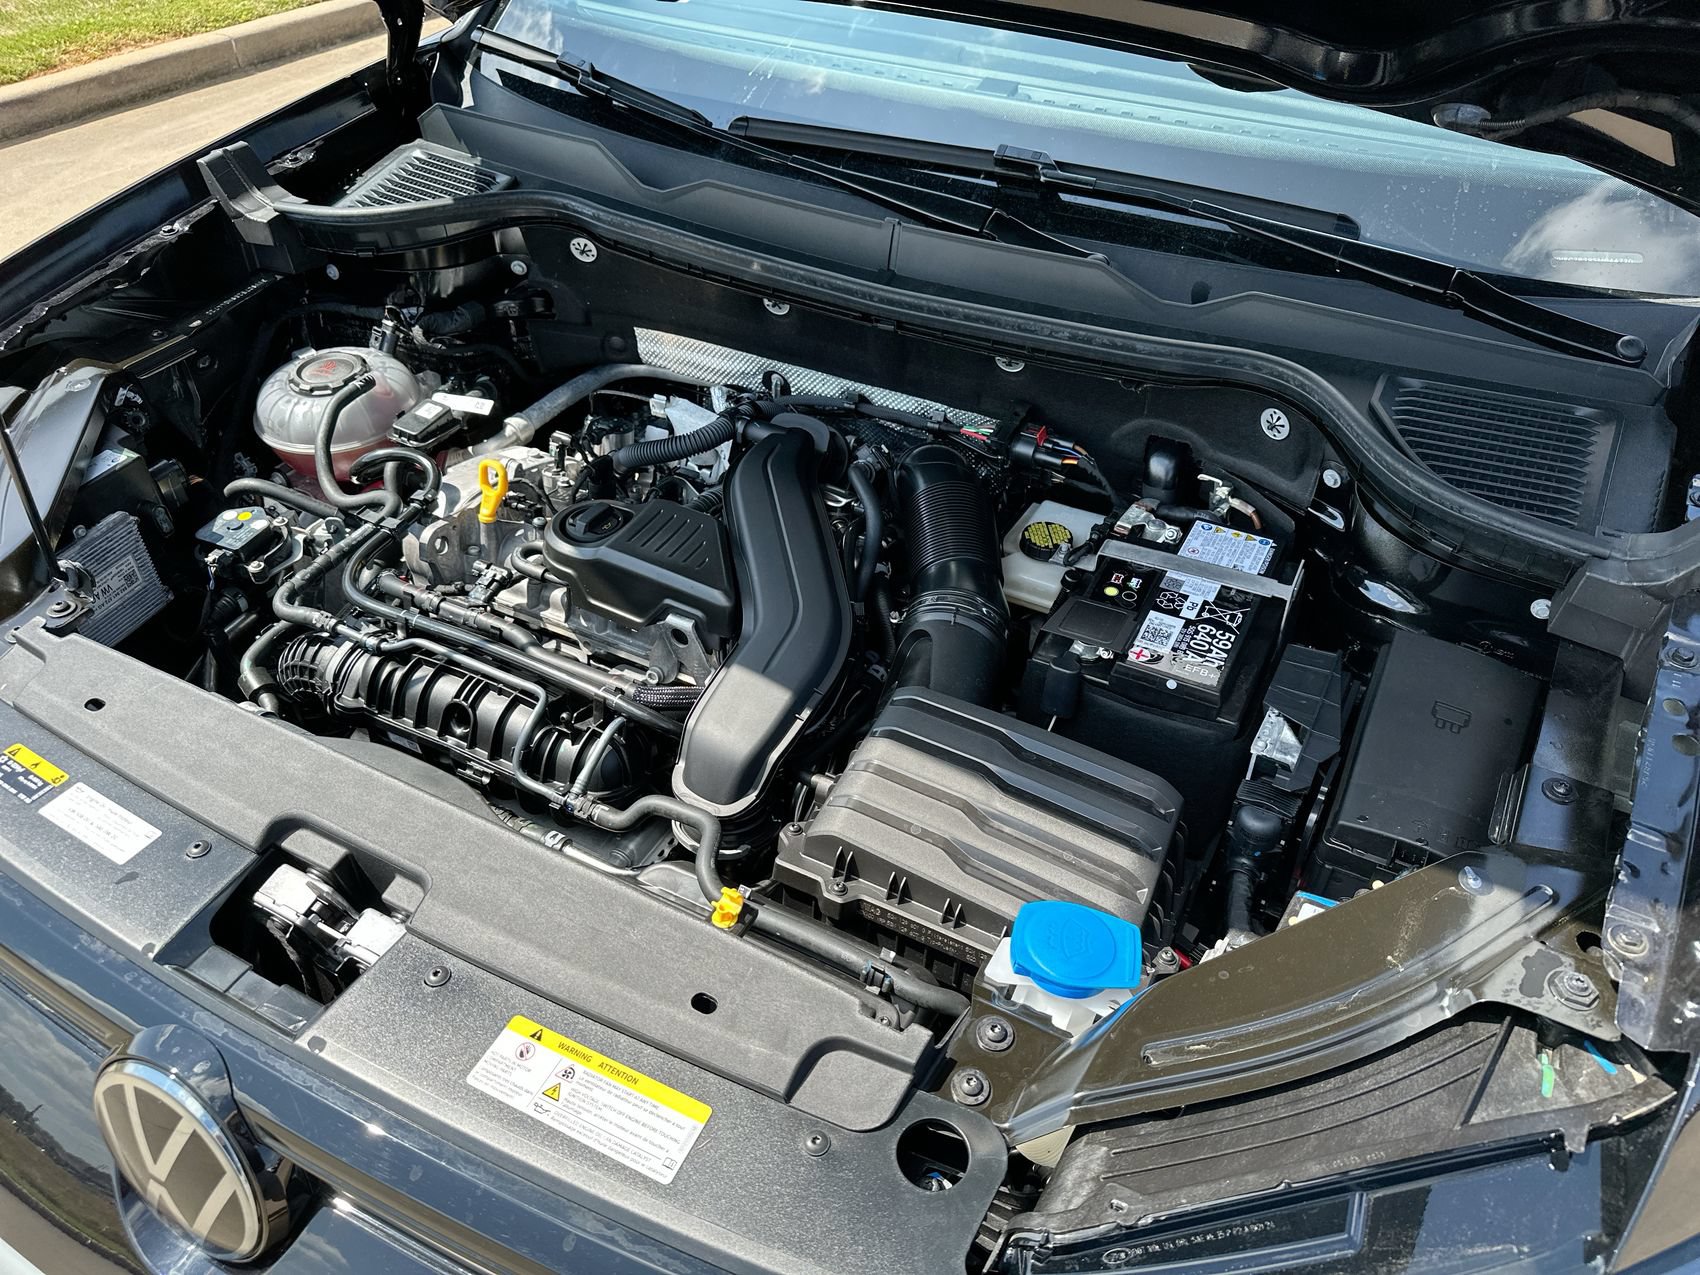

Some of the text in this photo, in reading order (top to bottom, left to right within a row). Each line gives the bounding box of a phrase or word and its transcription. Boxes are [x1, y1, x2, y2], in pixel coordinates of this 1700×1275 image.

[101, 584, 113, 597] VW
[1187, 602, 1199, 611] Pb
[1203, 630, 1236, 668] 59Ah
[1185, 664, 1216, 679] EFB+
[556, 1041, 639, 1085] WARNING ATTENTION
